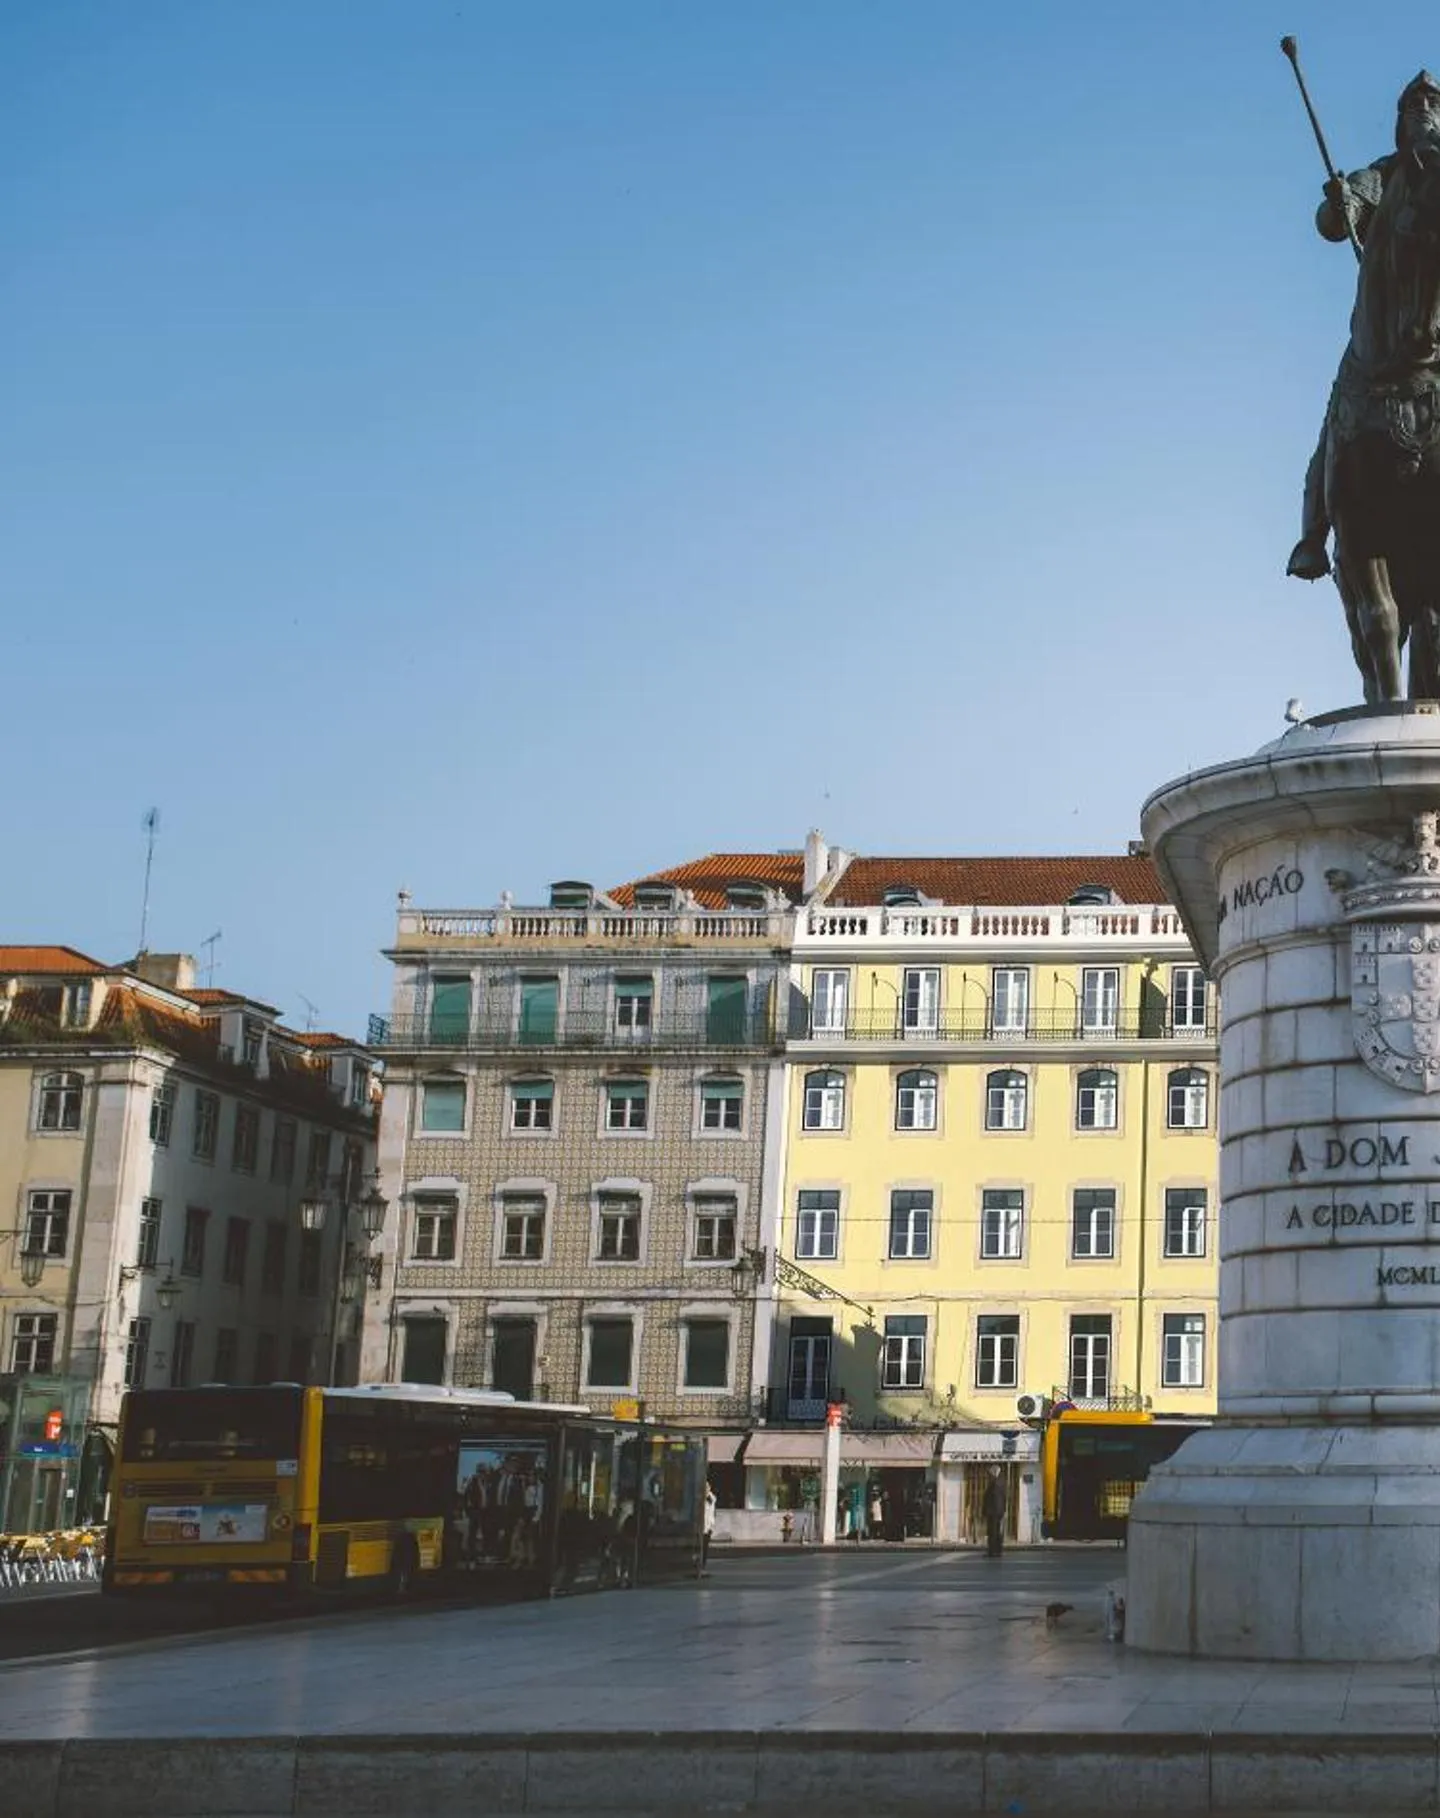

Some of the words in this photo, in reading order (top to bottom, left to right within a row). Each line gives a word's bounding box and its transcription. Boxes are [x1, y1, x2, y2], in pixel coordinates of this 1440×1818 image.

[1325, 1136, 1410, 1170] DOM
[1286, 1205, 1304, 1229] A
[1312, 1201, 1416, 1228] CIDADE
